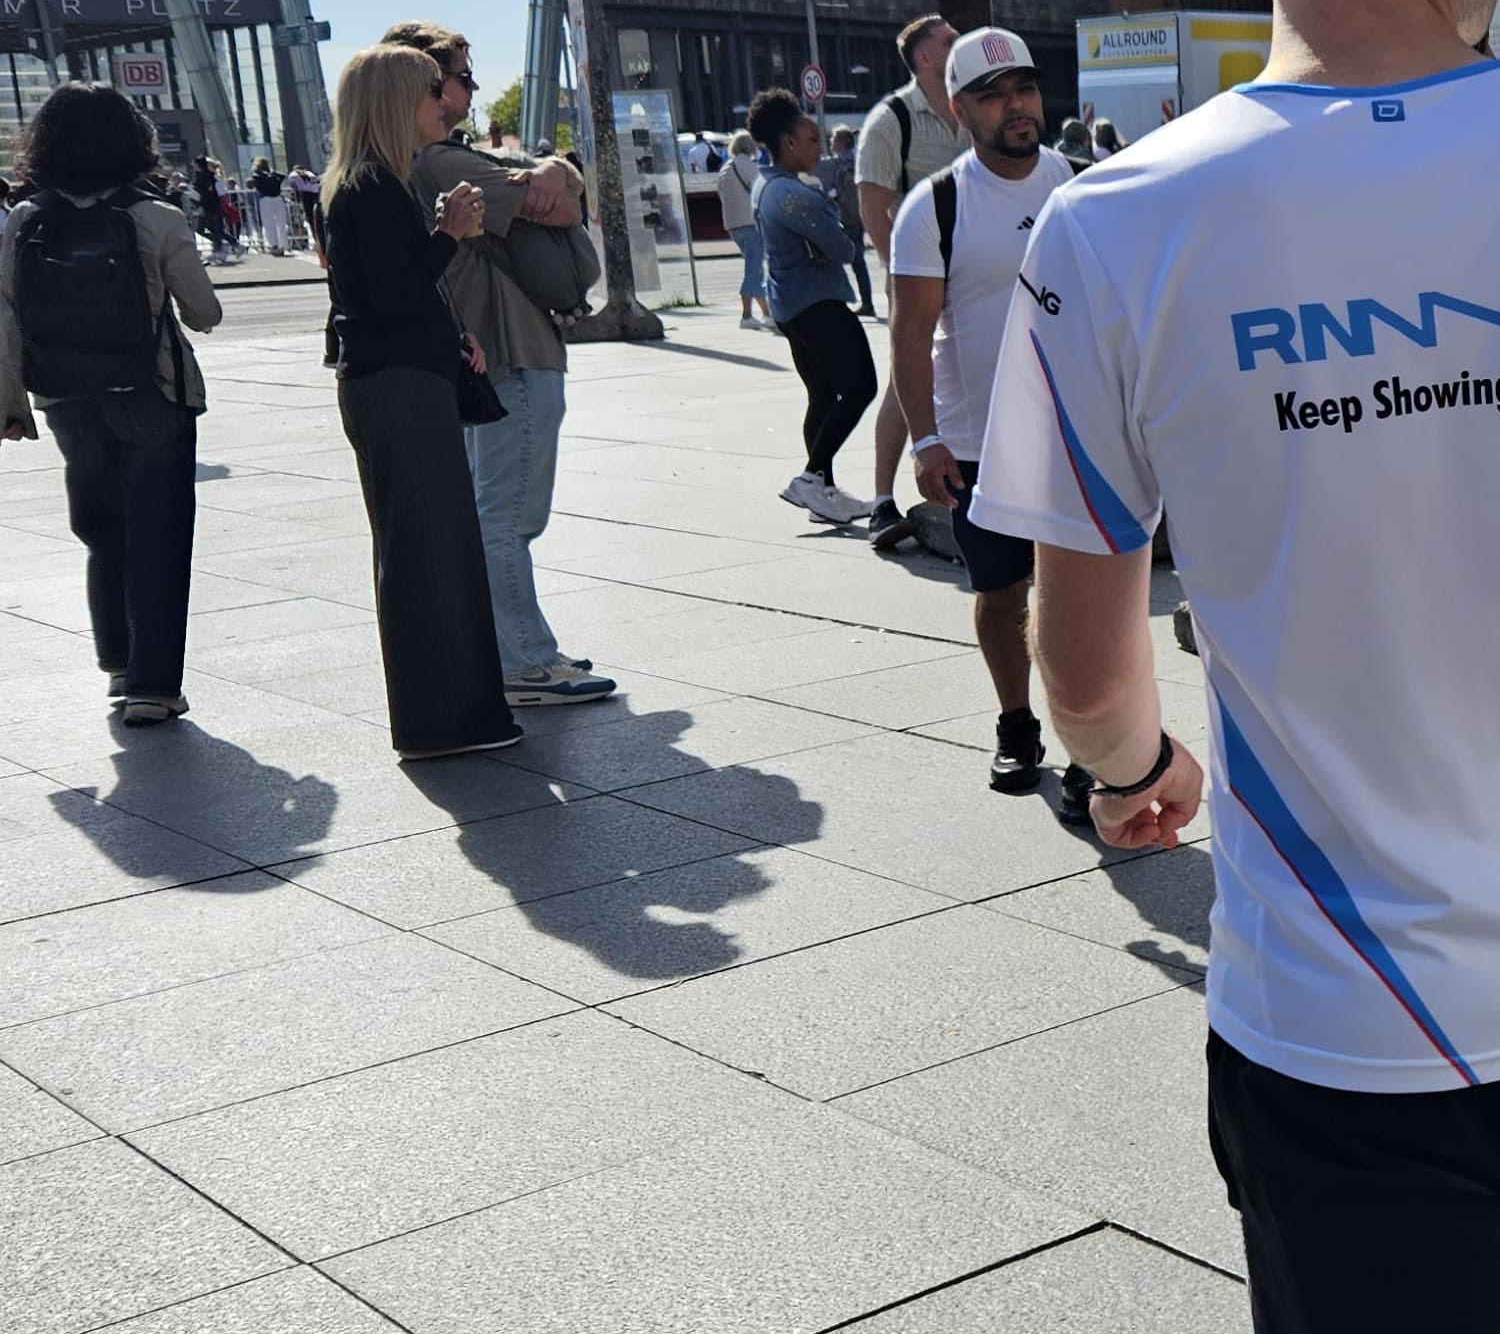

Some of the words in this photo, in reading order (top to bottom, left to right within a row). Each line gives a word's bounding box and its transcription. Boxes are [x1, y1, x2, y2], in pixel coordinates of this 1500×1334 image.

[1103, 29, 1168, 48] ALLROUND
[127, 65, 160, 83] DB
[806, 75, 821, 92] 30
[1274, 391, 1363, 434] Keep
